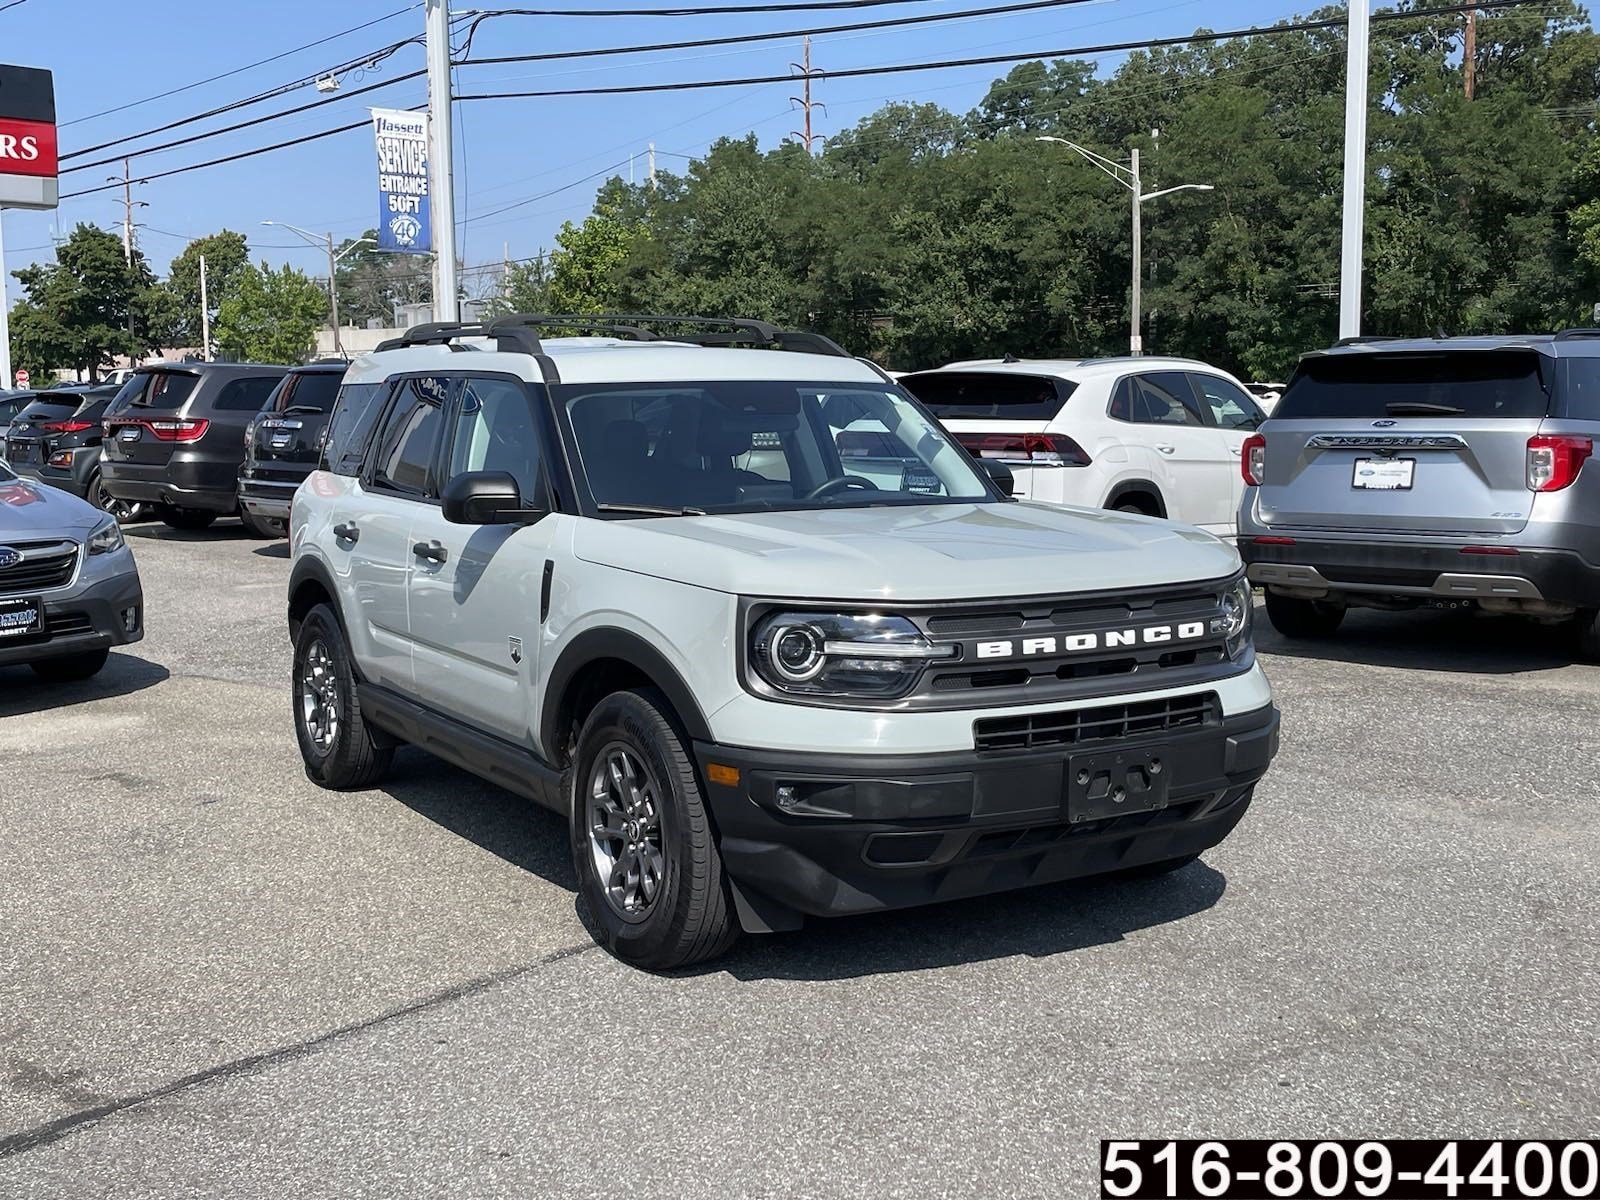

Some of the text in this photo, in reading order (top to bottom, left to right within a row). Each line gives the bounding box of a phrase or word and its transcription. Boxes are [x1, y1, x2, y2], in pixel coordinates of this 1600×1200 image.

[377, 136, 427, 175] SERVICE
[380, 174, 428, 196] ENTRANCE
[394, 222, 417, 239] 40
[976, 621, 1204, 658] BRONCO
